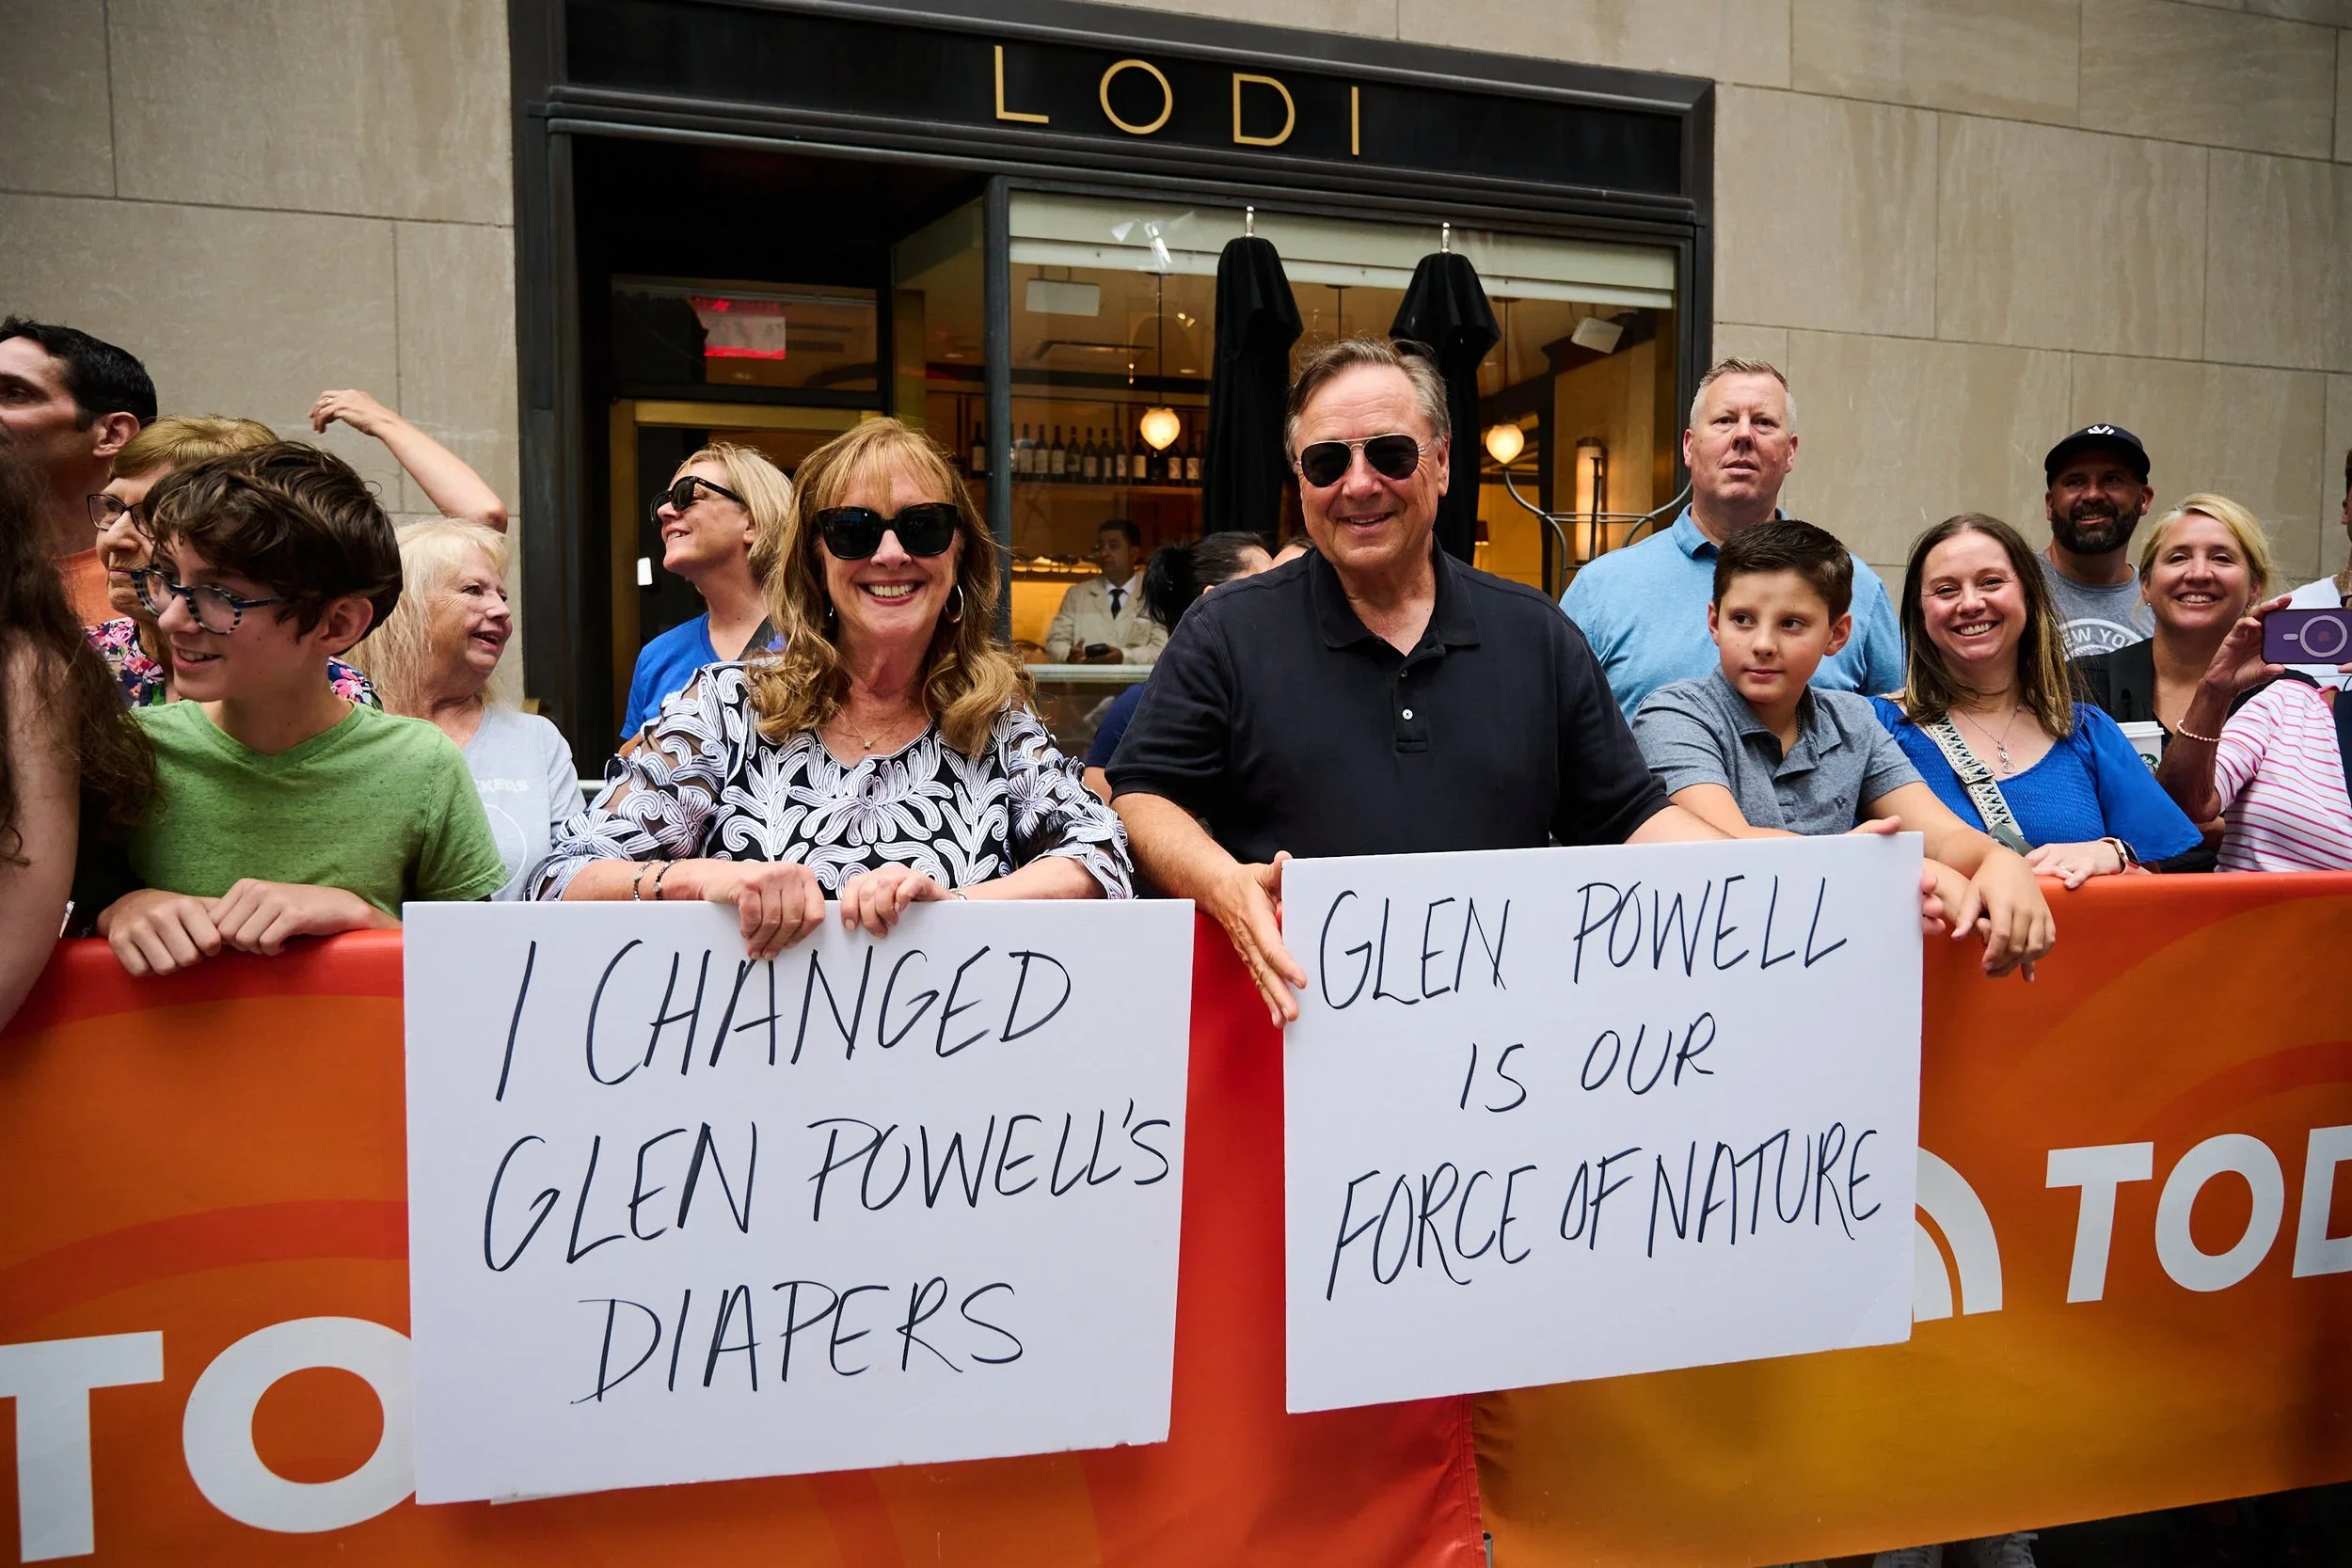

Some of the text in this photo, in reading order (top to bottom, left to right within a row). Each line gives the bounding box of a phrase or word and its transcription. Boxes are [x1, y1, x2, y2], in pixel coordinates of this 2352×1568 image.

[993, 44, 1360, 156] LODI
[2100, 628, 2135, 649] YO
[1318, 873, 1849, 1011] GLEN POWELL
[494, 938, 1073, 1103] I CHANGED
[1458, 1010, 1717, 1114] IS OUR
[483, 1097, 1171, 1274] GLEN POWELL'S
[1325, 1120, 1883, 1303] FORCE OF NATURE
[569, 1275, 1025, 1404] DIAPERS
